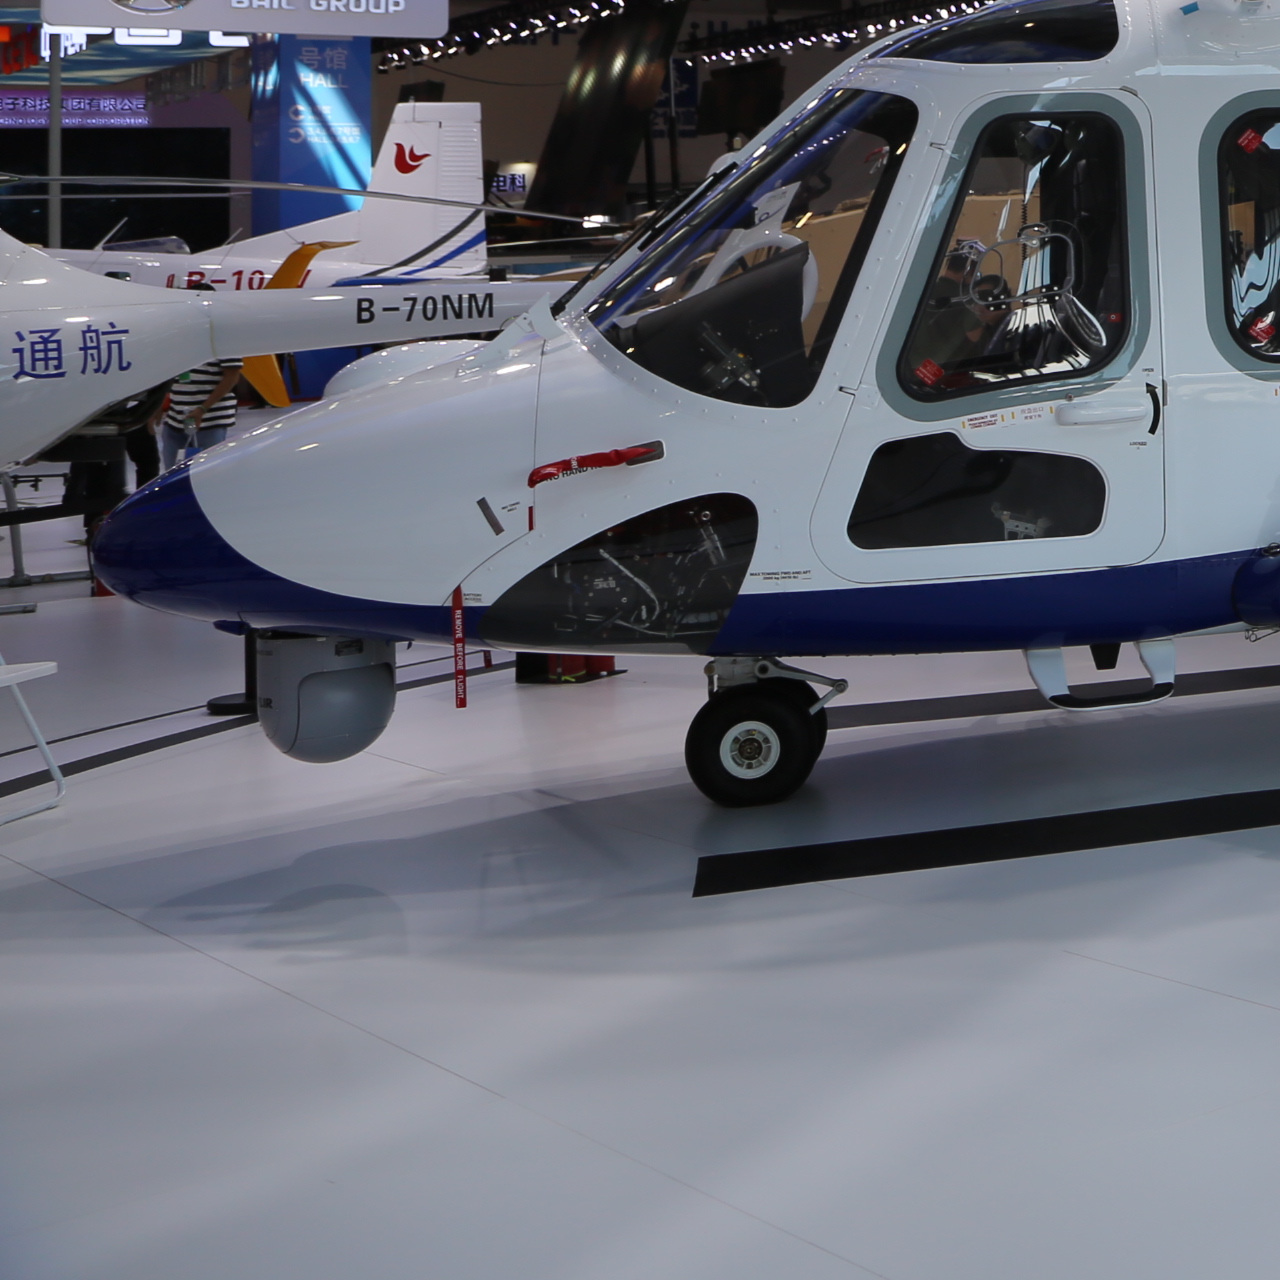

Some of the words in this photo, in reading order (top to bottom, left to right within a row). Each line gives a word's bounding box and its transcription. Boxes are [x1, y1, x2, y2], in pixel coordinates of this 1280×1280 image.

[300, 73, 348, 89] HALL
[356, 292, 496, 325] B-70NM
[12, 321, 133, 381] 通航
[454, 609, 463, 639] REMOVE
[456, 643, 464, 671] BEFORE
[456, 675, 465, 699] FLIGHT
